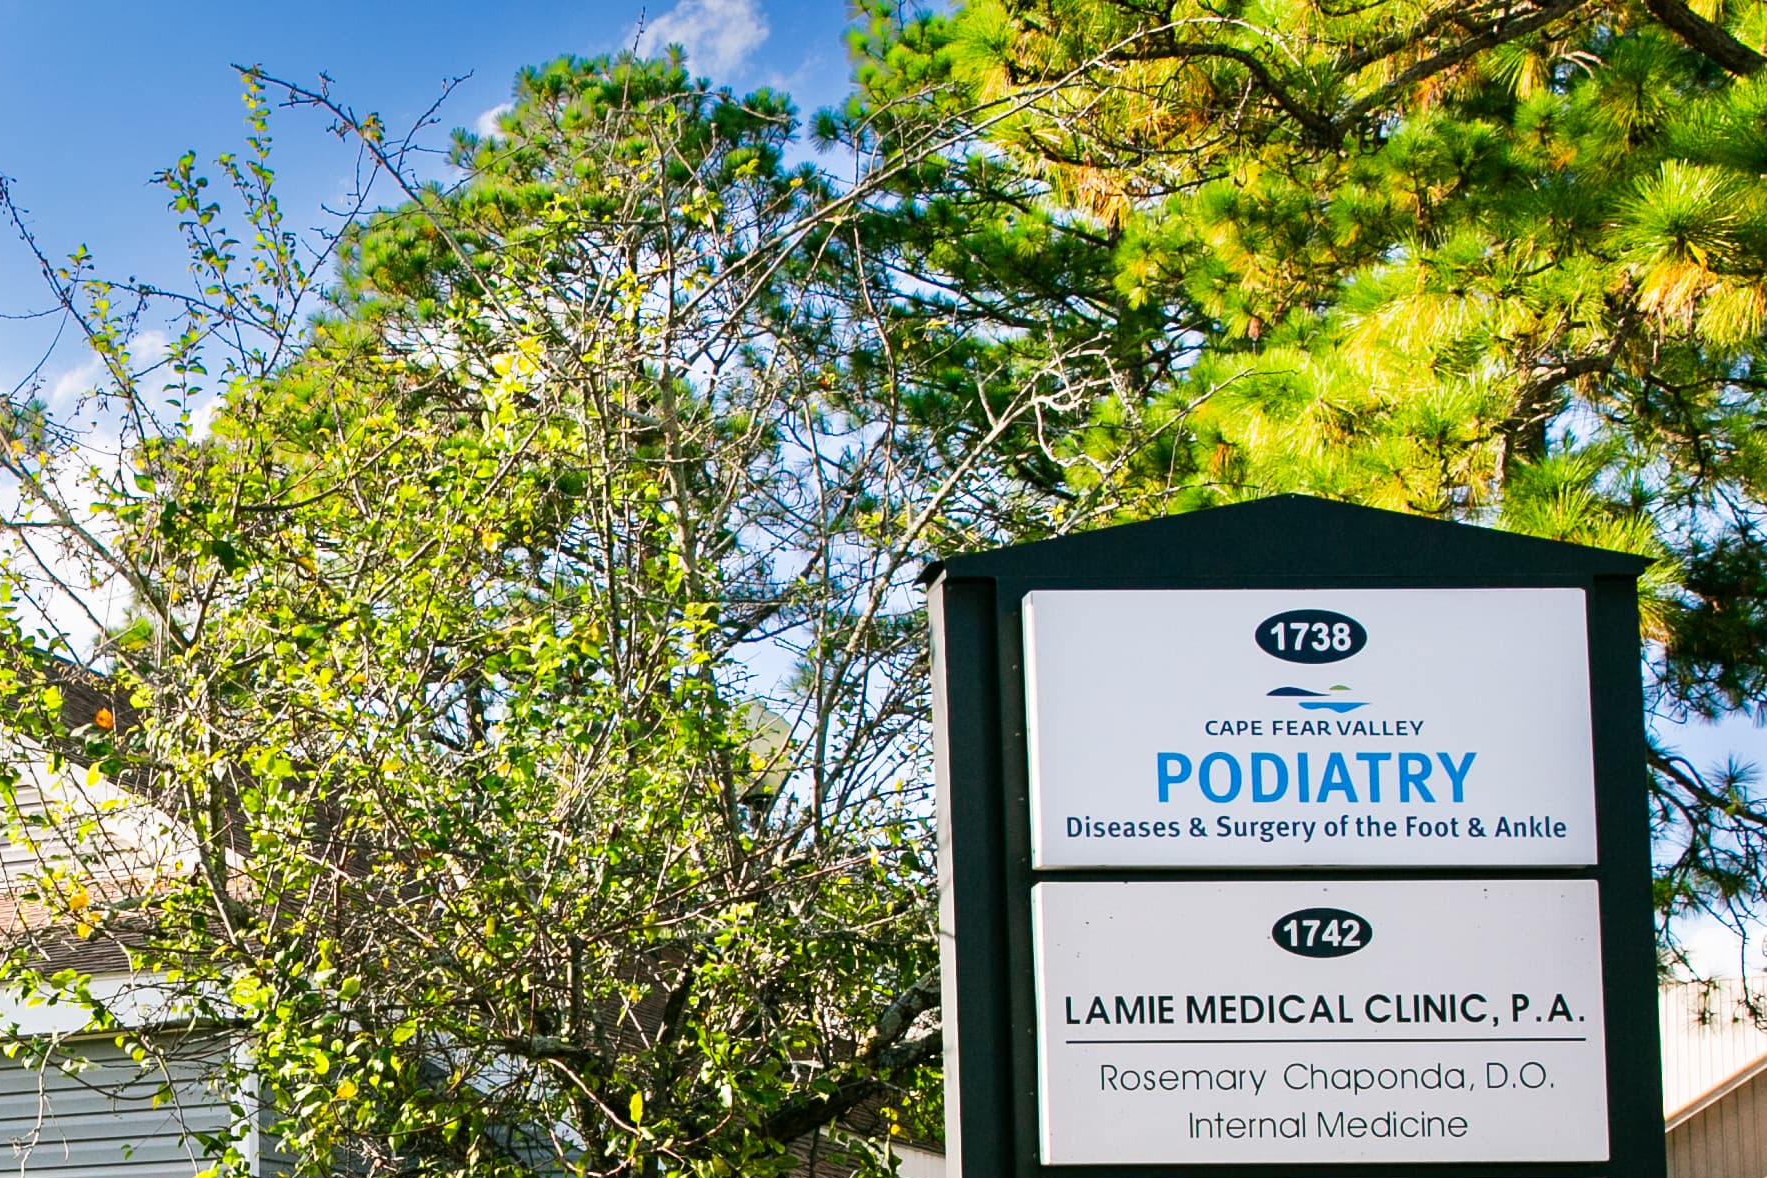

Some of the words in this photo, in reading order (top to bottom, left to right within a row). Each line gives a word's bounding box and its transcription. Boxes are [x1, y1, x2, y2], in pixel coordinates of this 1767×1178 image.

[1266, 622, 1351, 655] 1738
[1205, 721, 1263, 735] CAPE
[1273, 721, 1331, 735] FEAR
[1337, 721, 1424, 735] VALLEY
[1157, 752, 1477, 803] PODIATRY
[1067, 816, 1180, 837] Diseases
[1189, 818, 1208, 837] &
[1217, 816, 1316, 843] Surgery
[1324, 815, 1349, 836] of
[1356, 815, 1397, 837] the
[1407, 816, 1459, 837] Foot
[1468, 818, 1486, 837] &
[1495, 816, 1566, 837] Ankle
[1283, 920, 1362, 948] 1742
[1066, 996, 1174, 1024] LAMIE
[1187, 995, 1353, 1023] MEDICAL
[1365, 994, 1498, 1027] CLINIC,
[1512, 994, 1584, 1022] P.A.
[1101, 1065, 1266, 1095] Rosemary
[1284, 1063, 1474, 1095] Chaponda,
[1487, 1062, 1553, 1088] D.O.
[1190, 1112, 1305, 1138] Internal
[1318, 1111, 1468, 1138] Medicine
